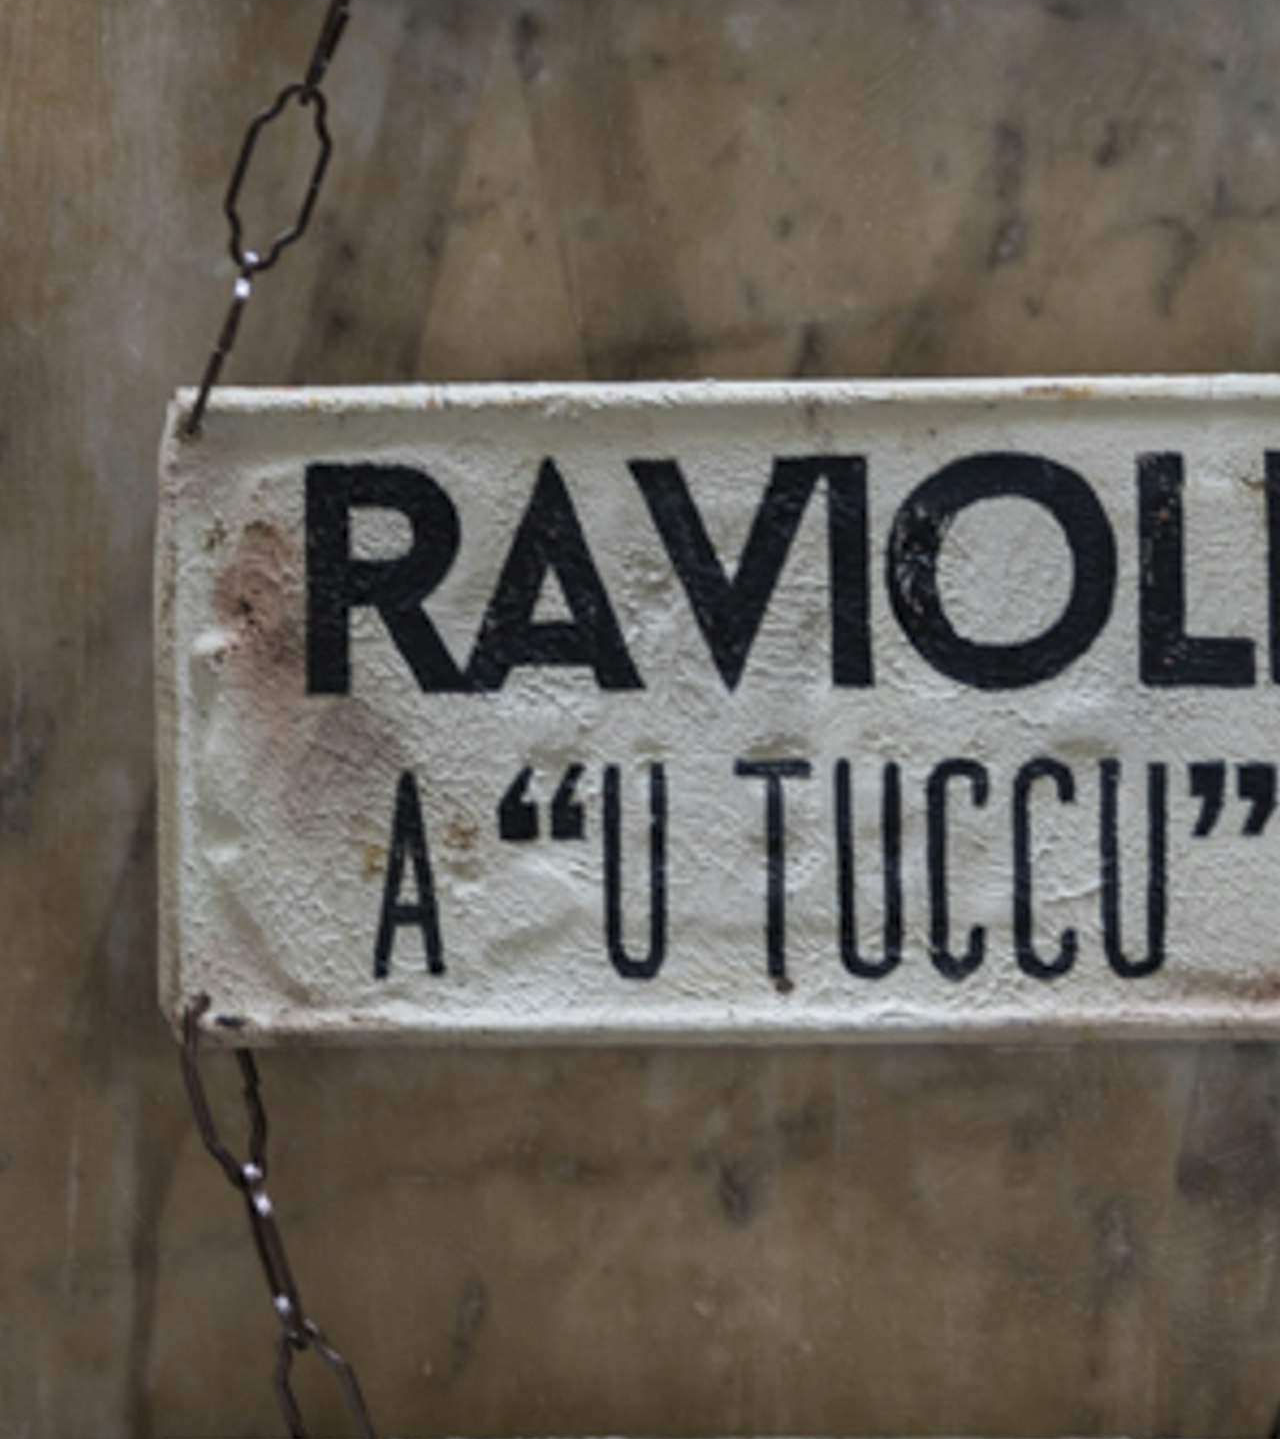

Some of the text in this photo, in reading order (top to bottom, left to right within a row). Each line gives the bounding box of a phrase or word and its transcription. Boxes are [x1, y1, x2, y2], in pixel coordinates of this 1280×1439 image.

[374, 757, 1277, 981] A “U TUCCU”
